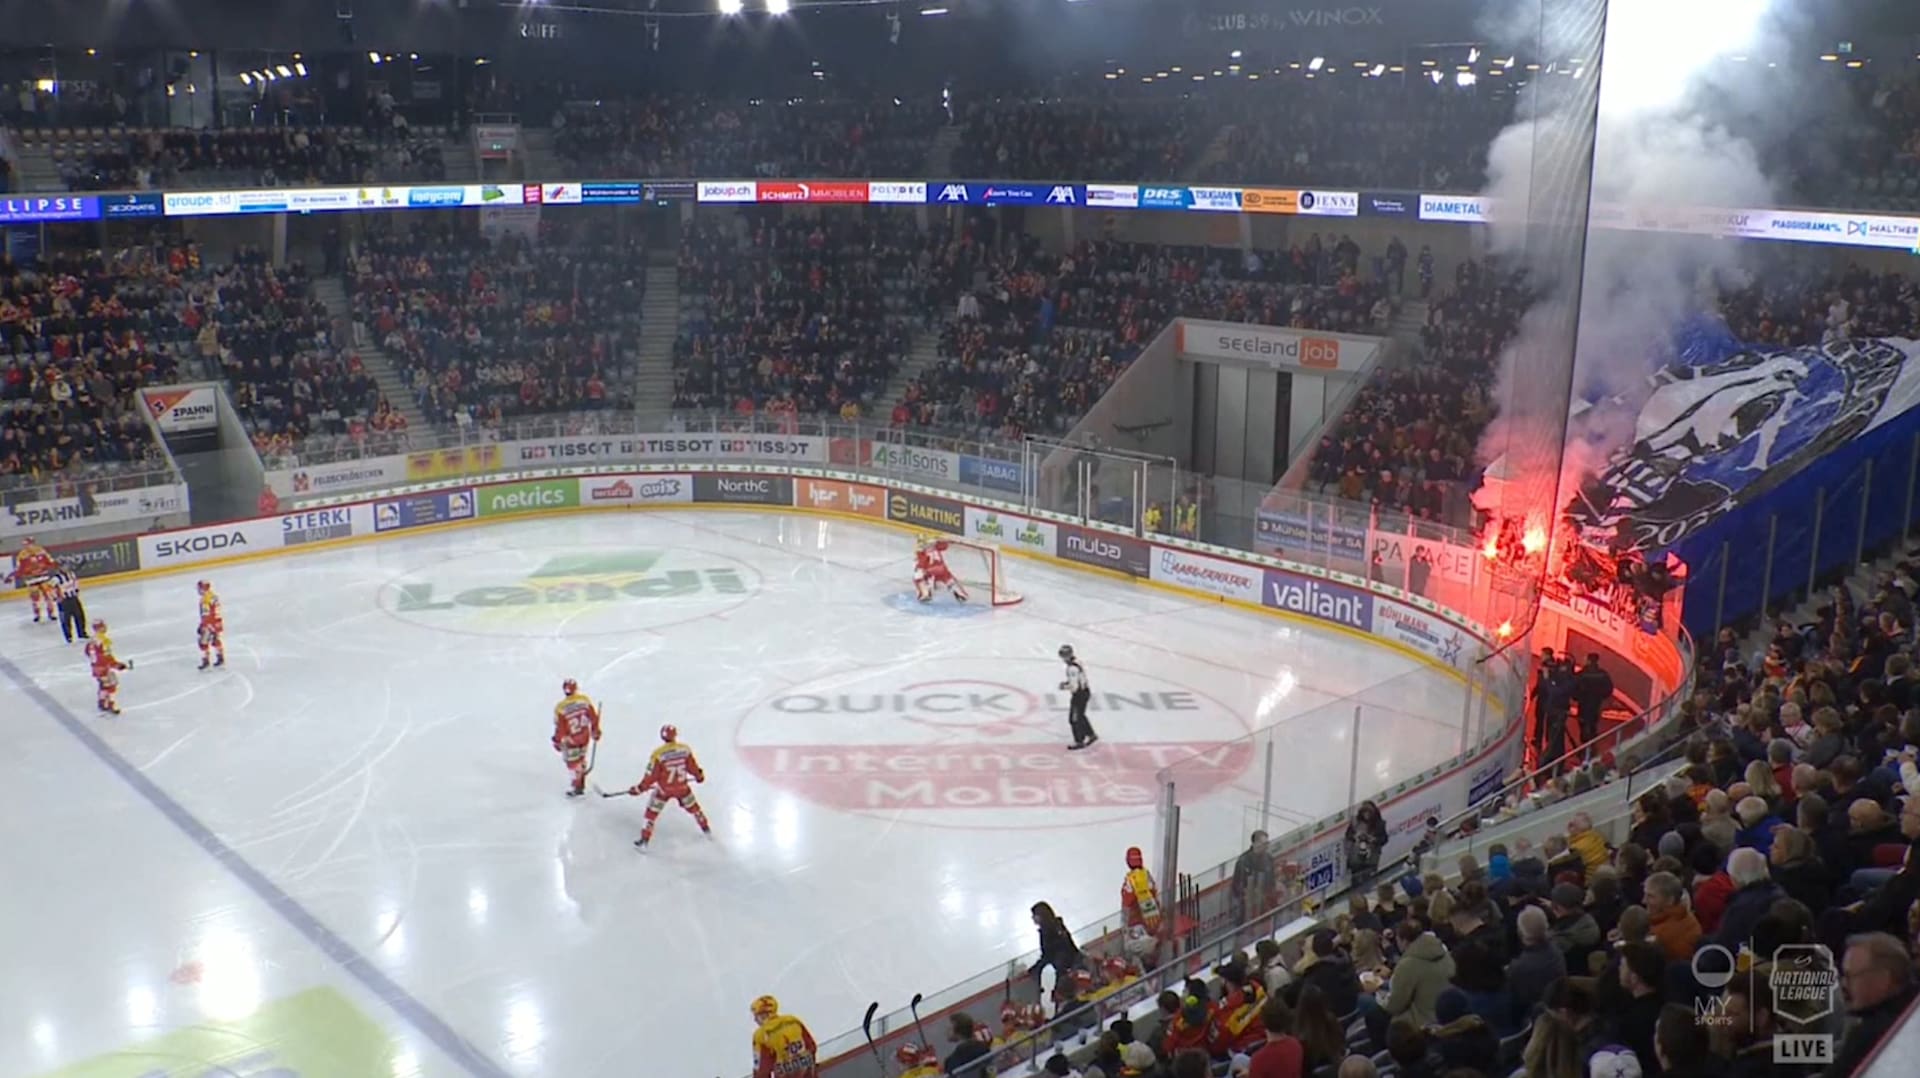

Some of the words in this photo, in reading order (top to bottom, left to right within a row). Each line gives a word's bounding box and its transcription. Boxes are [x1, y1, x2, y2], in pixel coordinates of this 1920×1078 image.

[1288, 7, 1384, 27] WINOX
[704, 185, 750, 197] jobup.ch
[761, 191, 804, 200] SCHMITZ
[811, 189, 864, 198] IMMOBILIEN
[938, 184, 968, 201] AXA
[1046, 186, 1076, 203] AXA
[1143, 188, 1183, 200] DRS
[0, 198, 82, 212] LIPSE
[1424, 202, 1482, 215] DIAMETAL
[1869, 224, 1919, 235] WALTHER
[1219, 336, 1298, 357] seeland
[1302, 342, 1336, 361] job
[648, 439, 713, 452] TISSOT
[718, 478, 769, 493] NorthC
[492, 486, 564, 510] netrics
[16, 504, 81, 526] SPAHN
[282, 509, 351, 531] STERKI
[910, 502, 961, 527] HARTING
[975, 518, 1004, 538] Landi
[1015, 526, 1045, 546] Landi
[156, 531, 247, 558] SKODA
[1067, 535, 1121, 560] muba
[397, 568, 747, 611] Landi
[1272, 581, 1362, 627] valiant
[568, 714, 589, 734] 24
[770, 745, 1093, 773] Internet
[1141, 748, 1231, 769] TV
[666, 766, 688, 784] 75
[869, 778, 1156, 808] Mobile
